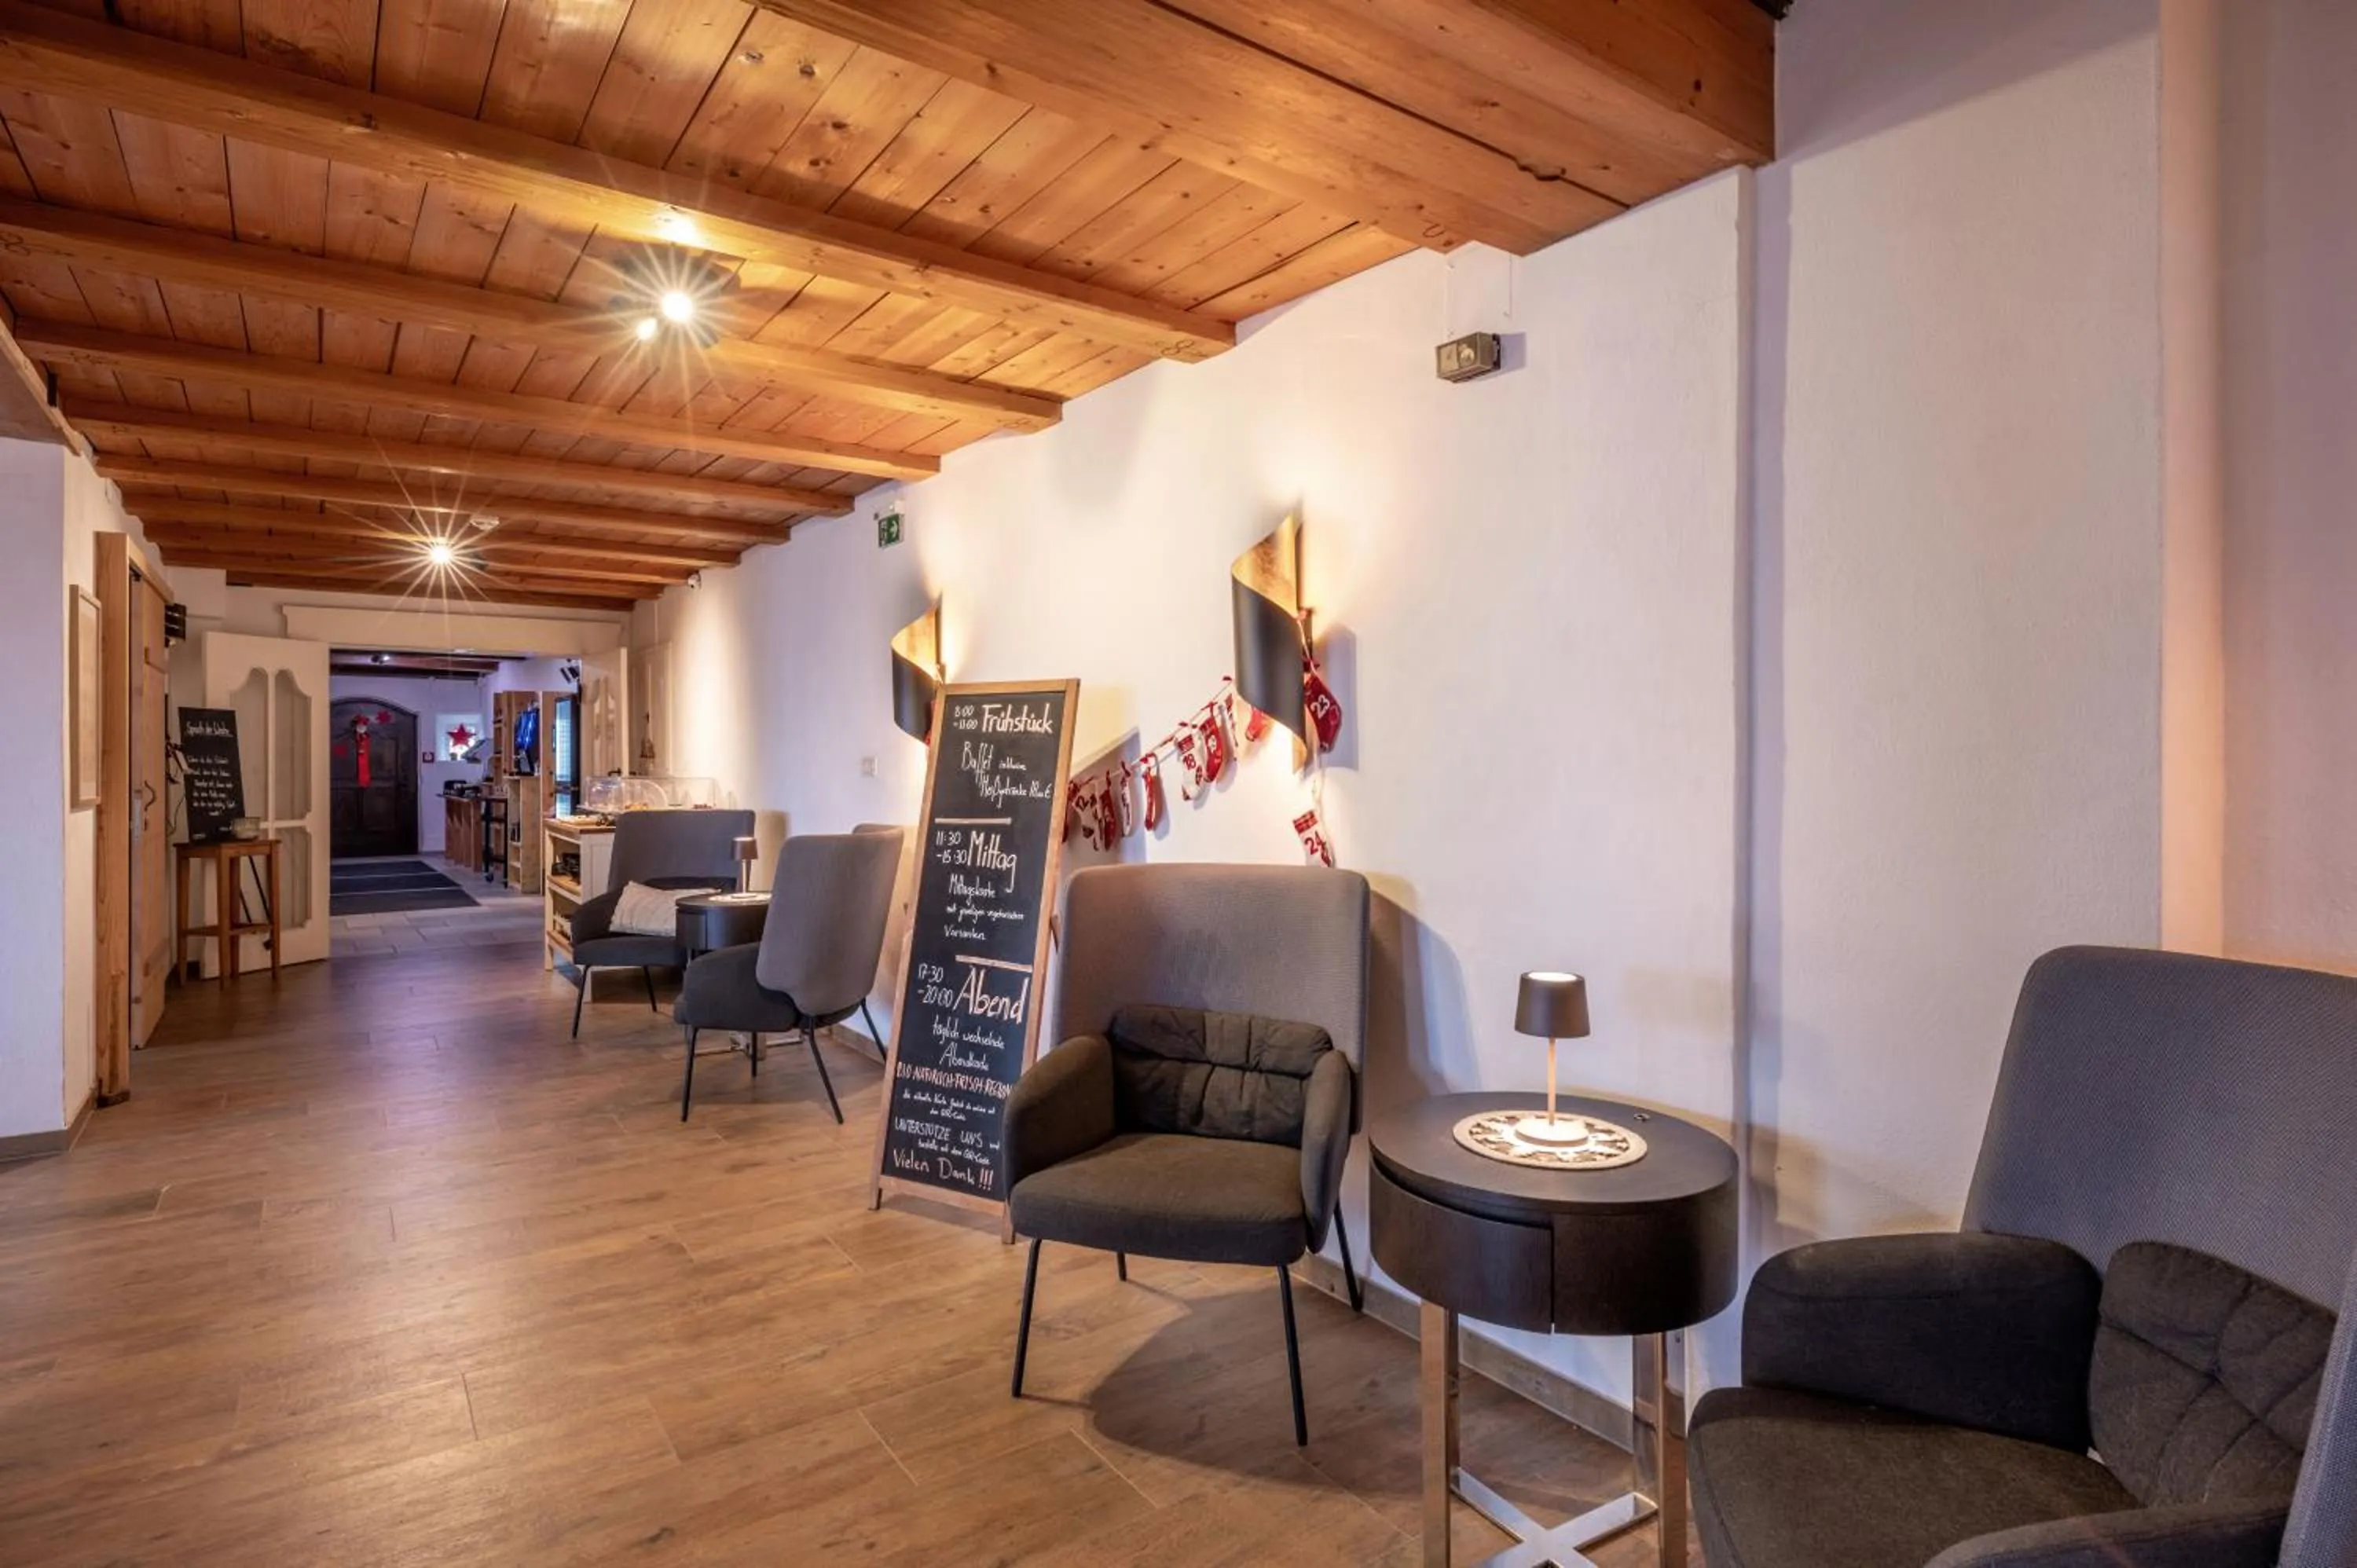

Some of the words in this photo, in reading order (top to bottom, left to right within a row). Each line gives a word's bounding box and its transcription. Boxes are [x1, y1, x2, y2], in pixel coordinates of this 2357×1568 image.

[981, 703, 1053, 734] Frühstück
[1310, 694, 1330, 720] 23
[1182, 753, 1197, 771] 18
[1304, 830, 1326, 858] 24
[936, 830, 962, 846] 11:30
[967, 830, 1017, 893] Mittag
[952, 965, 1030, 1024] Abend
[893, 1149, 930, 1173] Vielen
[937, 1156, 976, 1186] Dank
